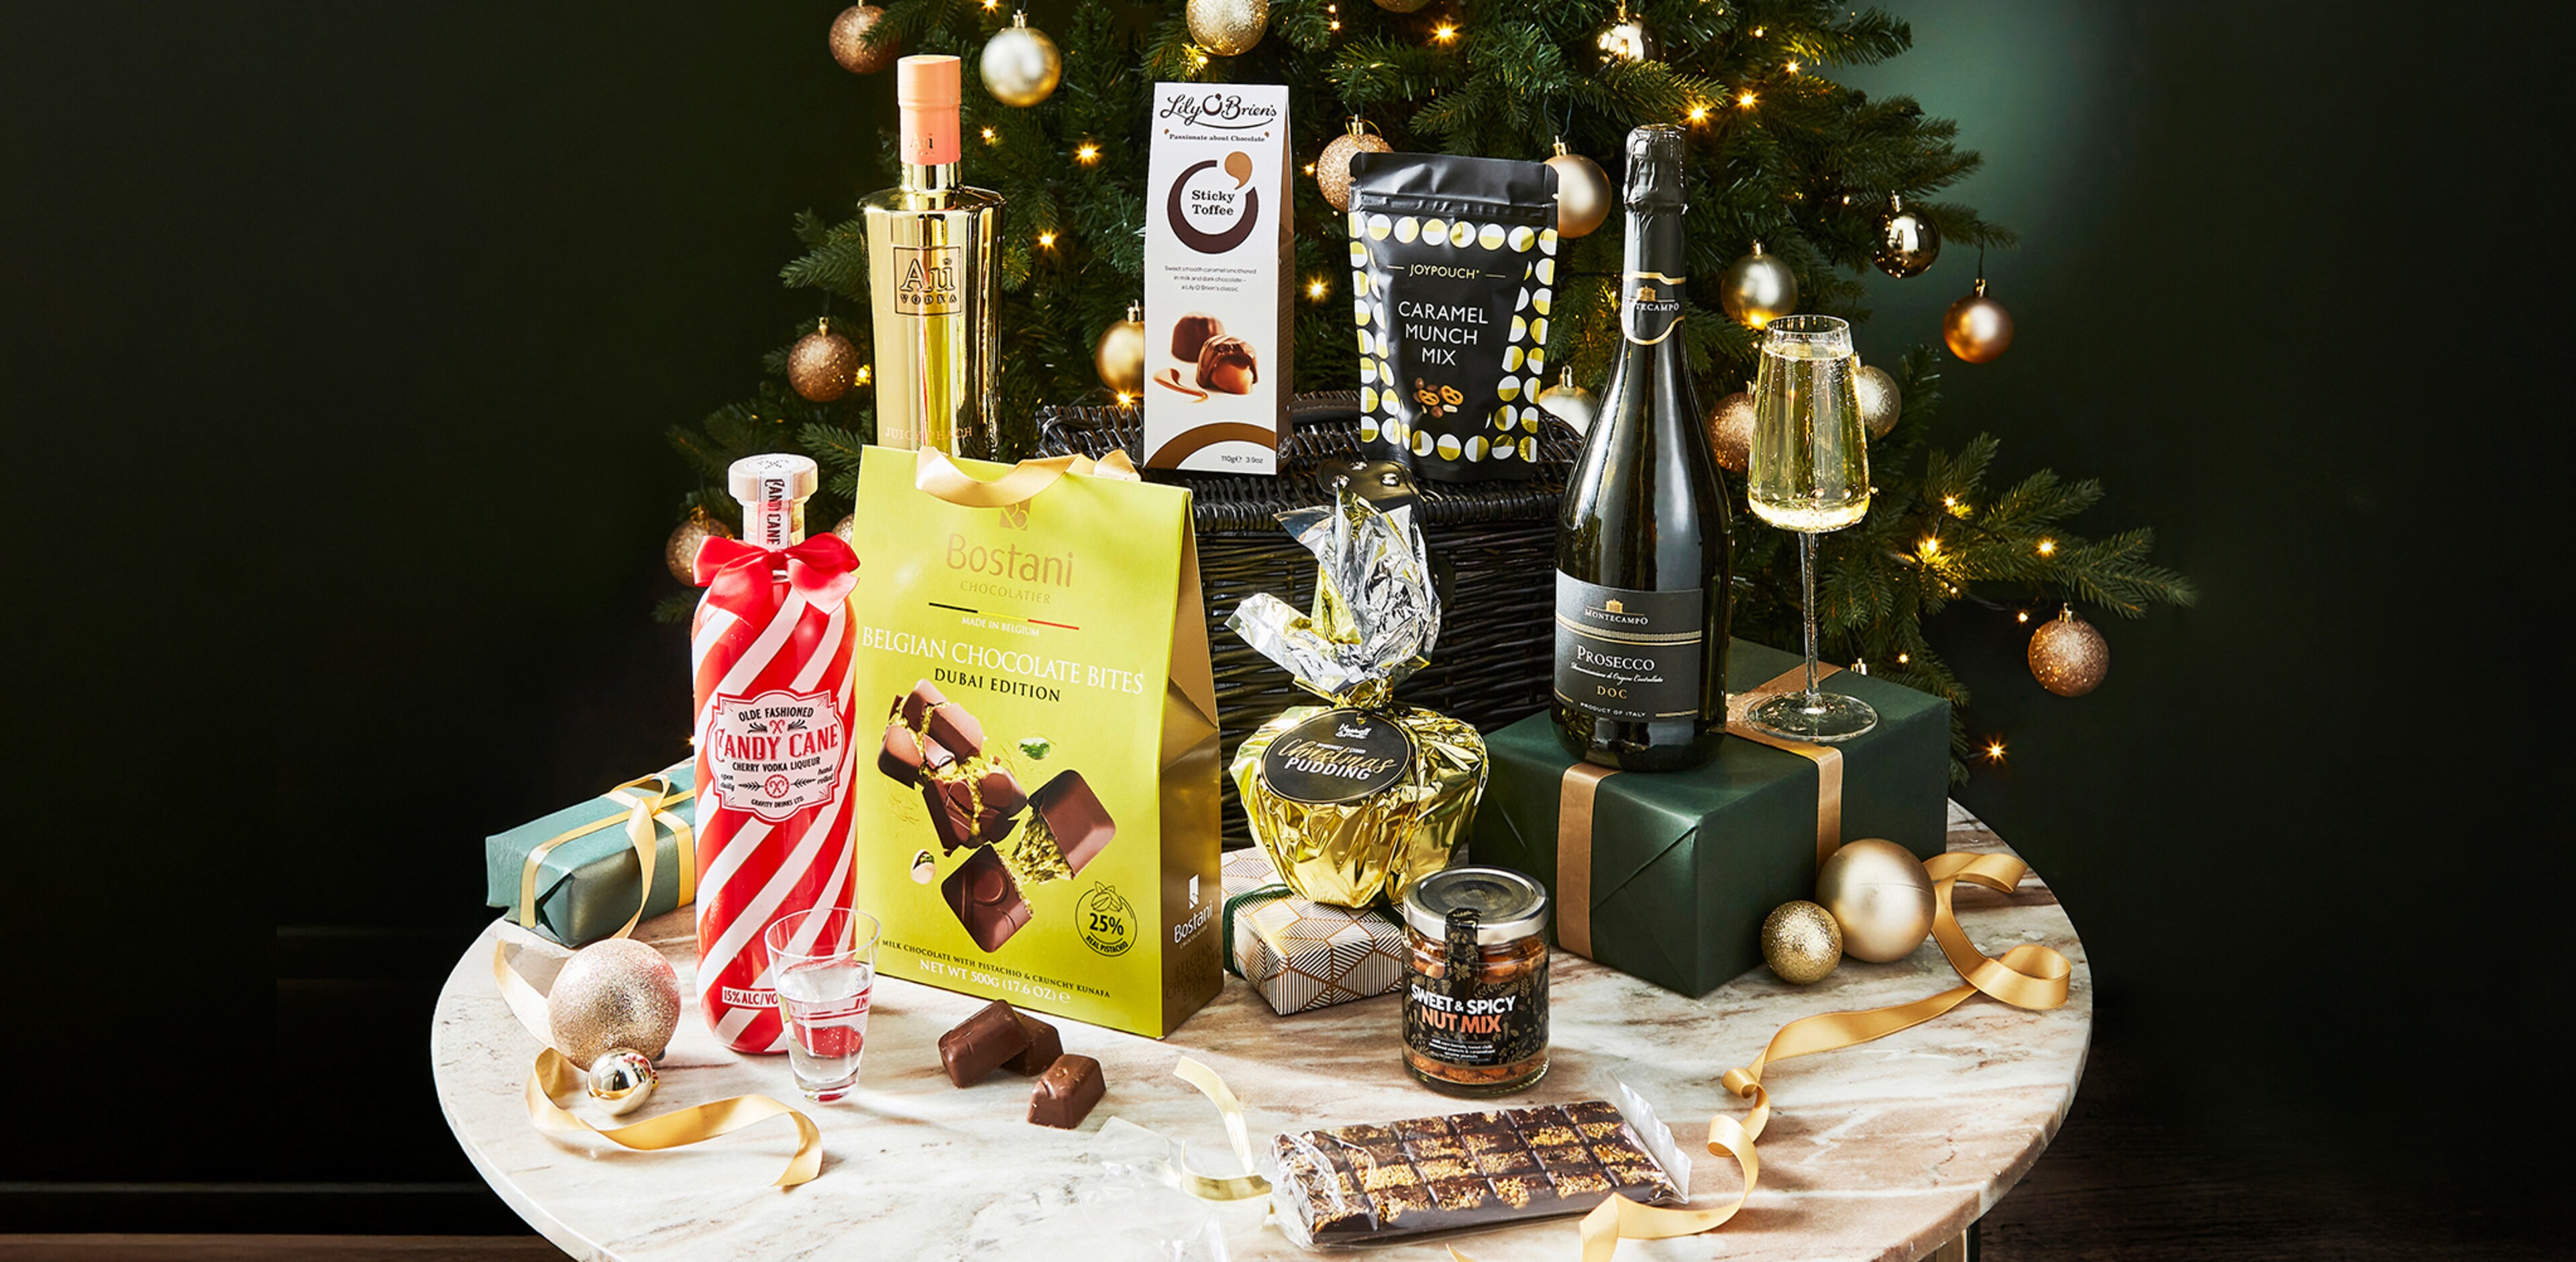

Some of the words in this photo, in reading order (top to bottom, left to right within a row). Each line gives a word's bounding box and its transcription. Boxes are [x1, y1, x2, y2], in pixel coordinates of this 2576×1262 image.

[1160, 94, 1202, 126] Lily
[1230, 134, 1265, 142] Chocolate
[1192, 190, 1235, 203] Sticky
[1192, 205, 1234, 215] Toffee
[1409, 264, 1475, 279] JOYPOUCH
[900, 294, 957, 305] VODKA
[1635, 302, 1680, 311] TECAMPO
[1398, 301, 1489, 324] CARAMEL
[1405, 323, 1478, 346] MUNCH
[1421, 347, 1456, 366] MIX
[927, 426, 973, 441] PEACH
[766, 513, 782, 545] CANE
[946, 533, 1073, 588] Bostani
[961, 580, 1051, 604] CHOCOLATIER
[961, 617, 986, 628] MADE
[989, 621, 1000, 630] IN
[1002, 623, 1039, 637] BELGIUM
[862, 626, 947, 660] BELGIAN
[952, 643, 1081, 684] CHOCOLATE
[1087, 665, 1144, 695] BITES
[1577, 644, 1655, 671] PROSECCO
[934, 668, 983, 688] DUBAI
[990, 677, 1061, 702] EDITION
[1597, 685, 1627, 699] DOC
[738, 708, 761, 722] OLDE
[765, 706, 814, 719] FASHIONED
[1580, 702, 1611, 714] PRODUCT
[715, 728, 782, 762] CANDY
[789, 723, 839, 757] CANE
[732, 761, 760, 772] CHERRY
[763, 761, 788, 772] VODKA
[790, 756, 821, 770] LIQUEUR
[1278, 738, 1397, 774] Christmas
[1284, 757, 1373, 780] PUDDING
[774, 798, 793, 808] DRINKS
[1089, 912, 1124, 935] 25%
[1174, 900, 1213, 943] Bostani
[1085, 935, 1099, 949] REAL
[1100, 941, 1128, 953] PISTACHIO
[882, 940, 902, 950] MILK
[904, 944, 951, 961] CHOCOLATE
[953, 956, 975, 967] WITH
[978, 961, 1022, 978] PISTACHIO
[1032, 974, 1074, 990] CRUNCHY
[1076, 984, 1110, 998] KUNAFA
[920, 959, 945, 975] NET
[947, 965, 967, 980] WT
[971, 971, 1000, 988] 500G
[1002, 980, 1030, 995] (17.6
[1032, 986, 1056, 1002] OZ)
[724, 990, 741, 1003] 15%
[742, 992, 778, 1005] ALC/VO
[1411, 983, 1454, 1012] SWEET
[1454, 1000, 1464, 1012] &
[1466, 995, 1516, 1015] SPICY
[1421, 1005, 1458, 1032] NUT
[1460, 1014, 1501, 1034] MIX
